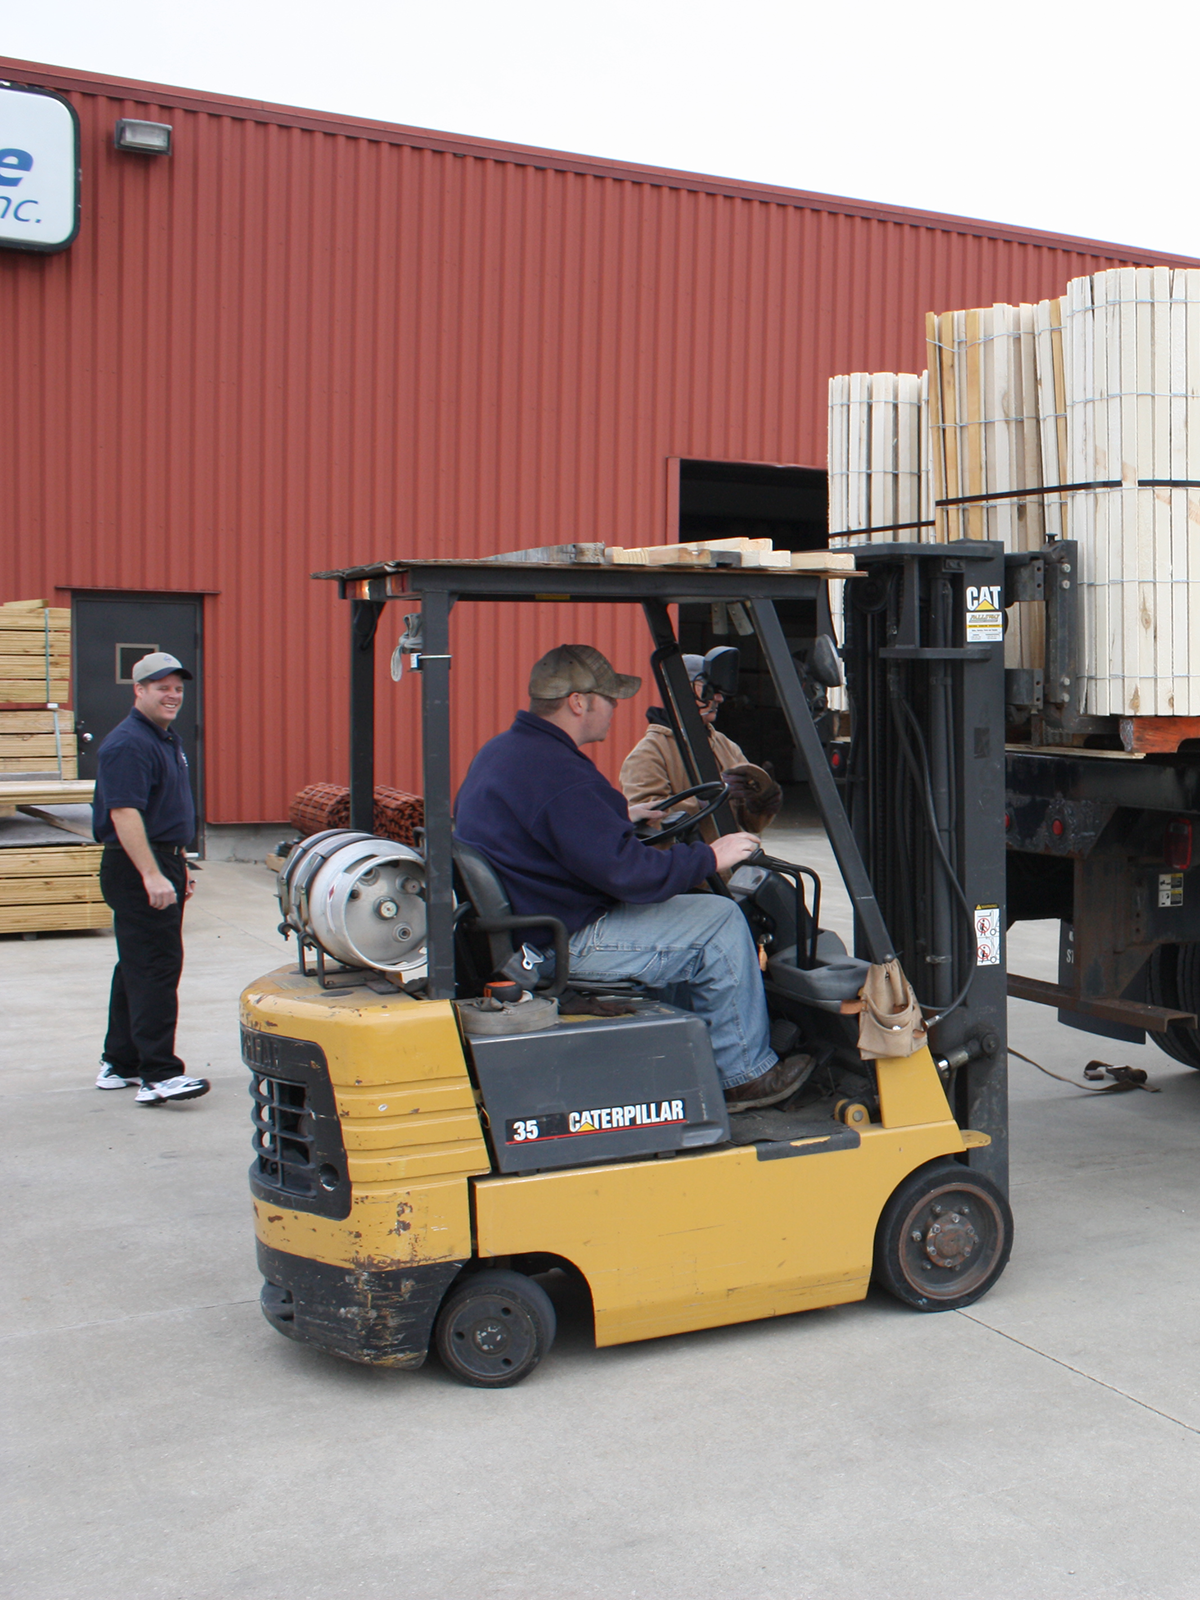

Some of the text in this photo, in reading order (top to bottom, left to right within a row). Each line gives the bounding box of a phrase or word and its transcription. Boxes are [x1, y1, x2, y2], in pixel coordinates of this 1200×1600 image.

[966, 586, 1001, 611] CAT
[513, 1099, 685, 1141] 35 CATERPILLAR
